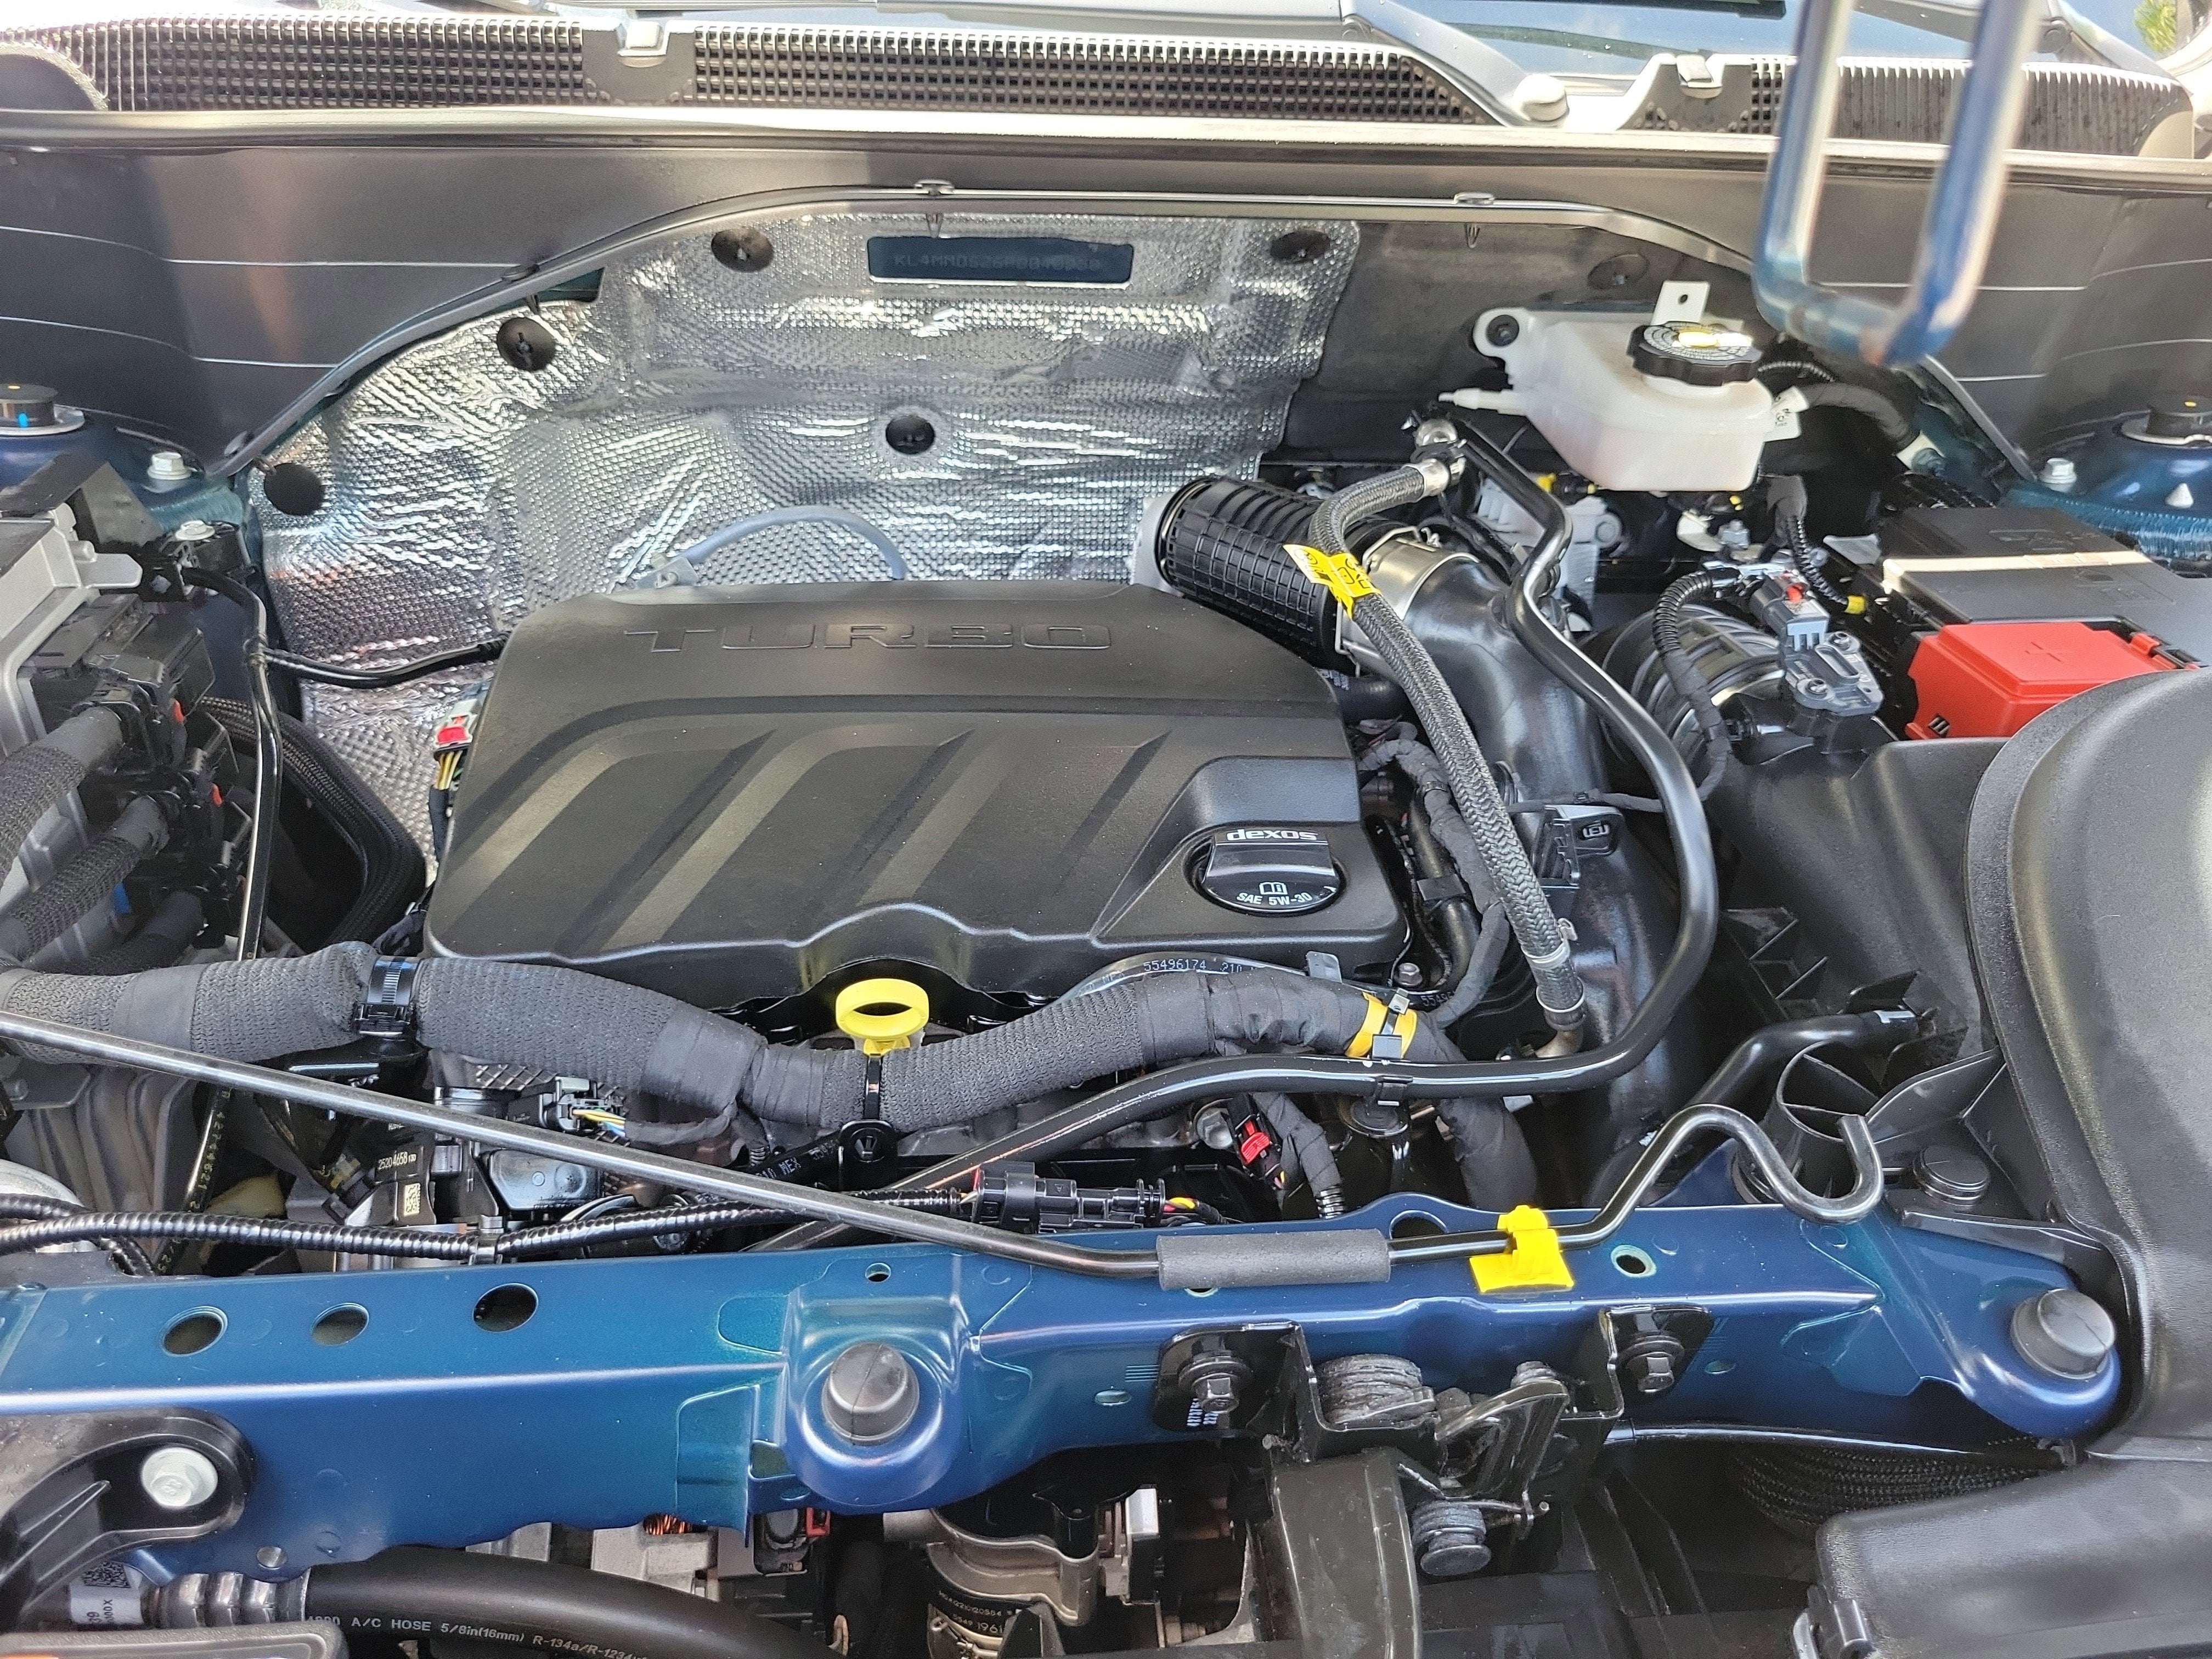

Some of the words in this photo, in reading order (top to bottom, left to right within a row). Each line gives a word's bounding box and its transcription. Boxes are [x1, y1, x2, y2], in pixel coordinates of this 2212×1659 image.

[624, 623, 1113, 653] TURBO
[1226, 829, 1318, 841] dexos
[1237, 892, 1263, 905] SAE
[1269, 892, 1313, 906] 5W-30
[1144, 960, 1206, 972] 55496174
[352, 1617, 381, 1628] A/C
[391, 1619, 432, 1631] HOSE
[441, 1623, 524, 1641] 5/8in(16mm)
